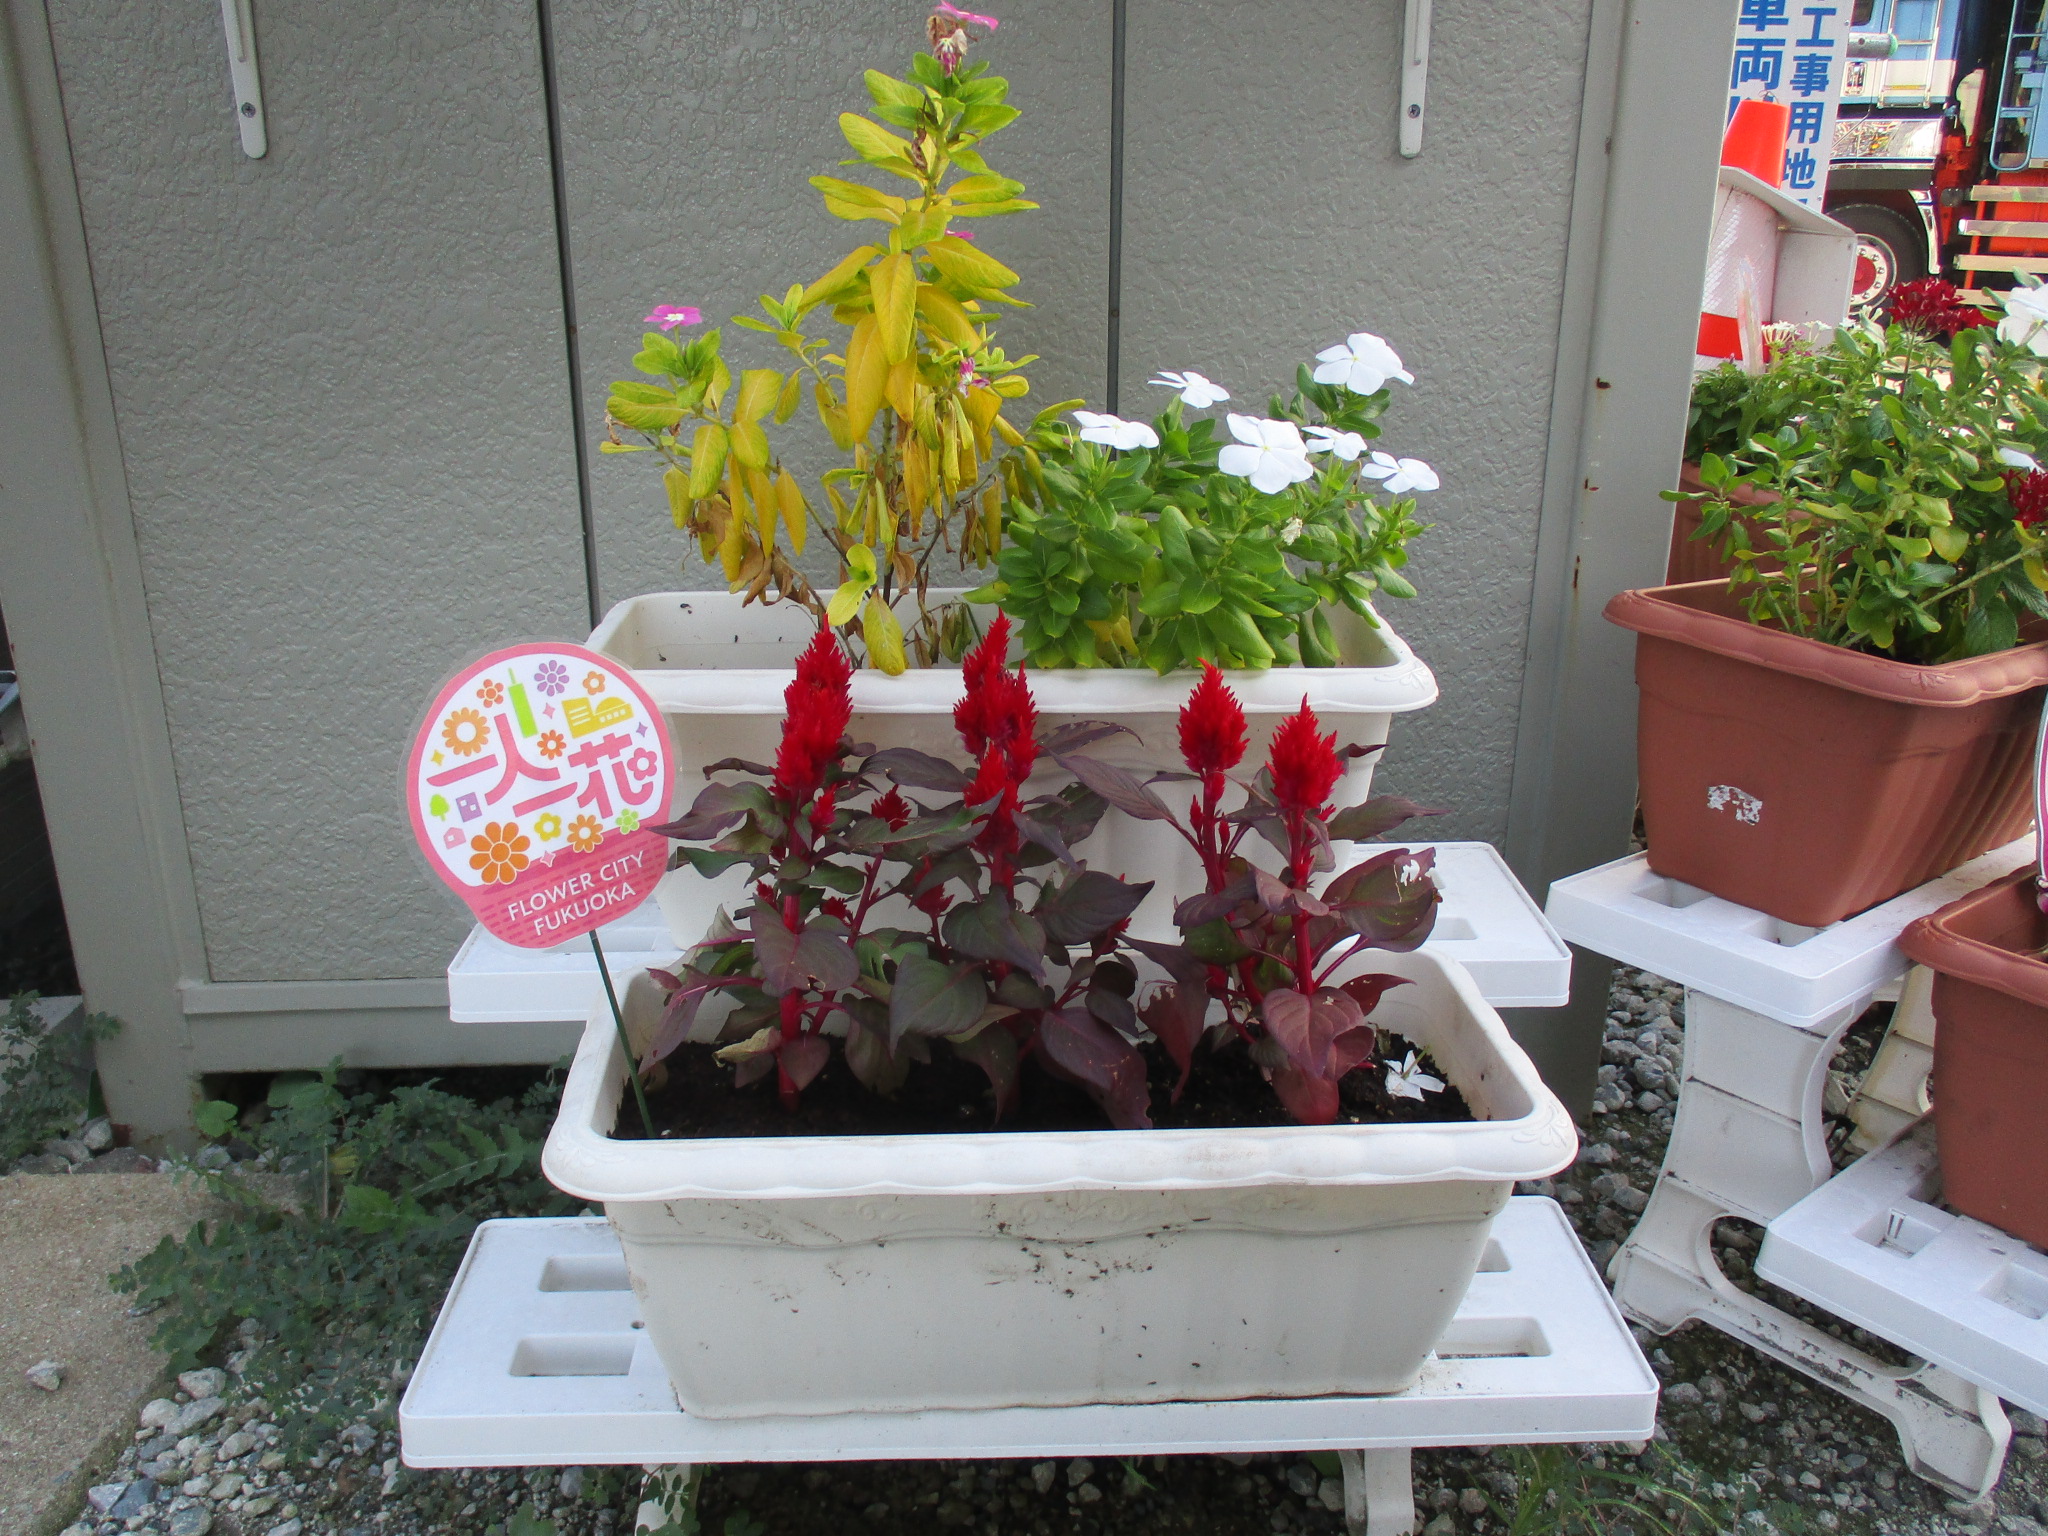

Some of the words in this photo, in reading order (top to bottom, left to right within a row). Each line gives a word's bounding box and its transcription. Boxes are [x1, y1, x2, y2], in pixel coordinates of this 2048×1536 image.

[1728, 0, 1789, 126] 車両
[1782, 8, 1837, 205] 工事用地
[426, 713, 658, 820] 一人一花
[507, 872, 595, 921] FLOWER
[599, 850, 645, 883] CITY
[533, 881, 637, 936] FUKUOKA
